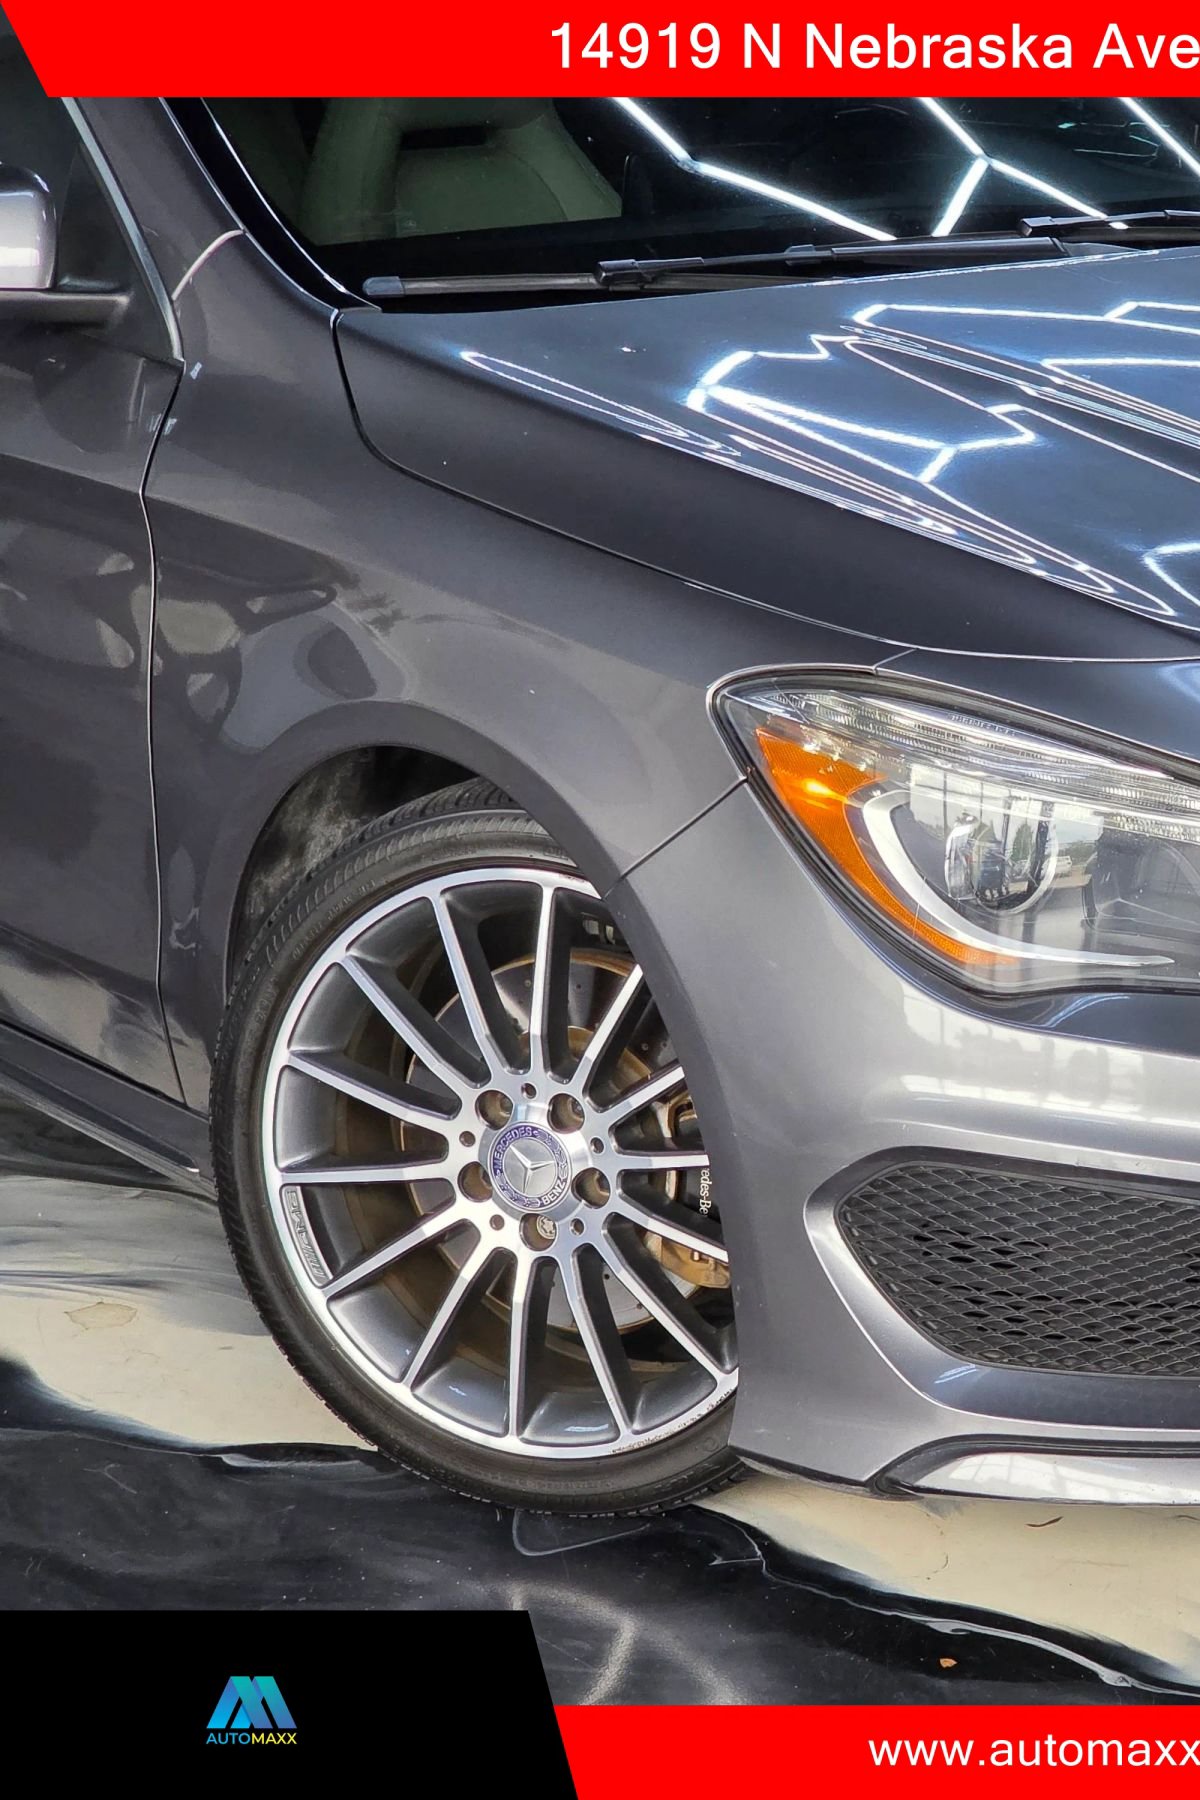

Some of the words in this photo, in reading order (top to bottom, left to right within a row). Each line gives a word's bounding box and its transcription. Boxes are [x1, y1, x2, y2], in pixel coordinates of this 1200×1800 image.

[493, 1126, 533, 1170] MERCEDES
[541, 1180, 566, 1205] BENZ
[699, 1168, 713, 1217] edes-Be
